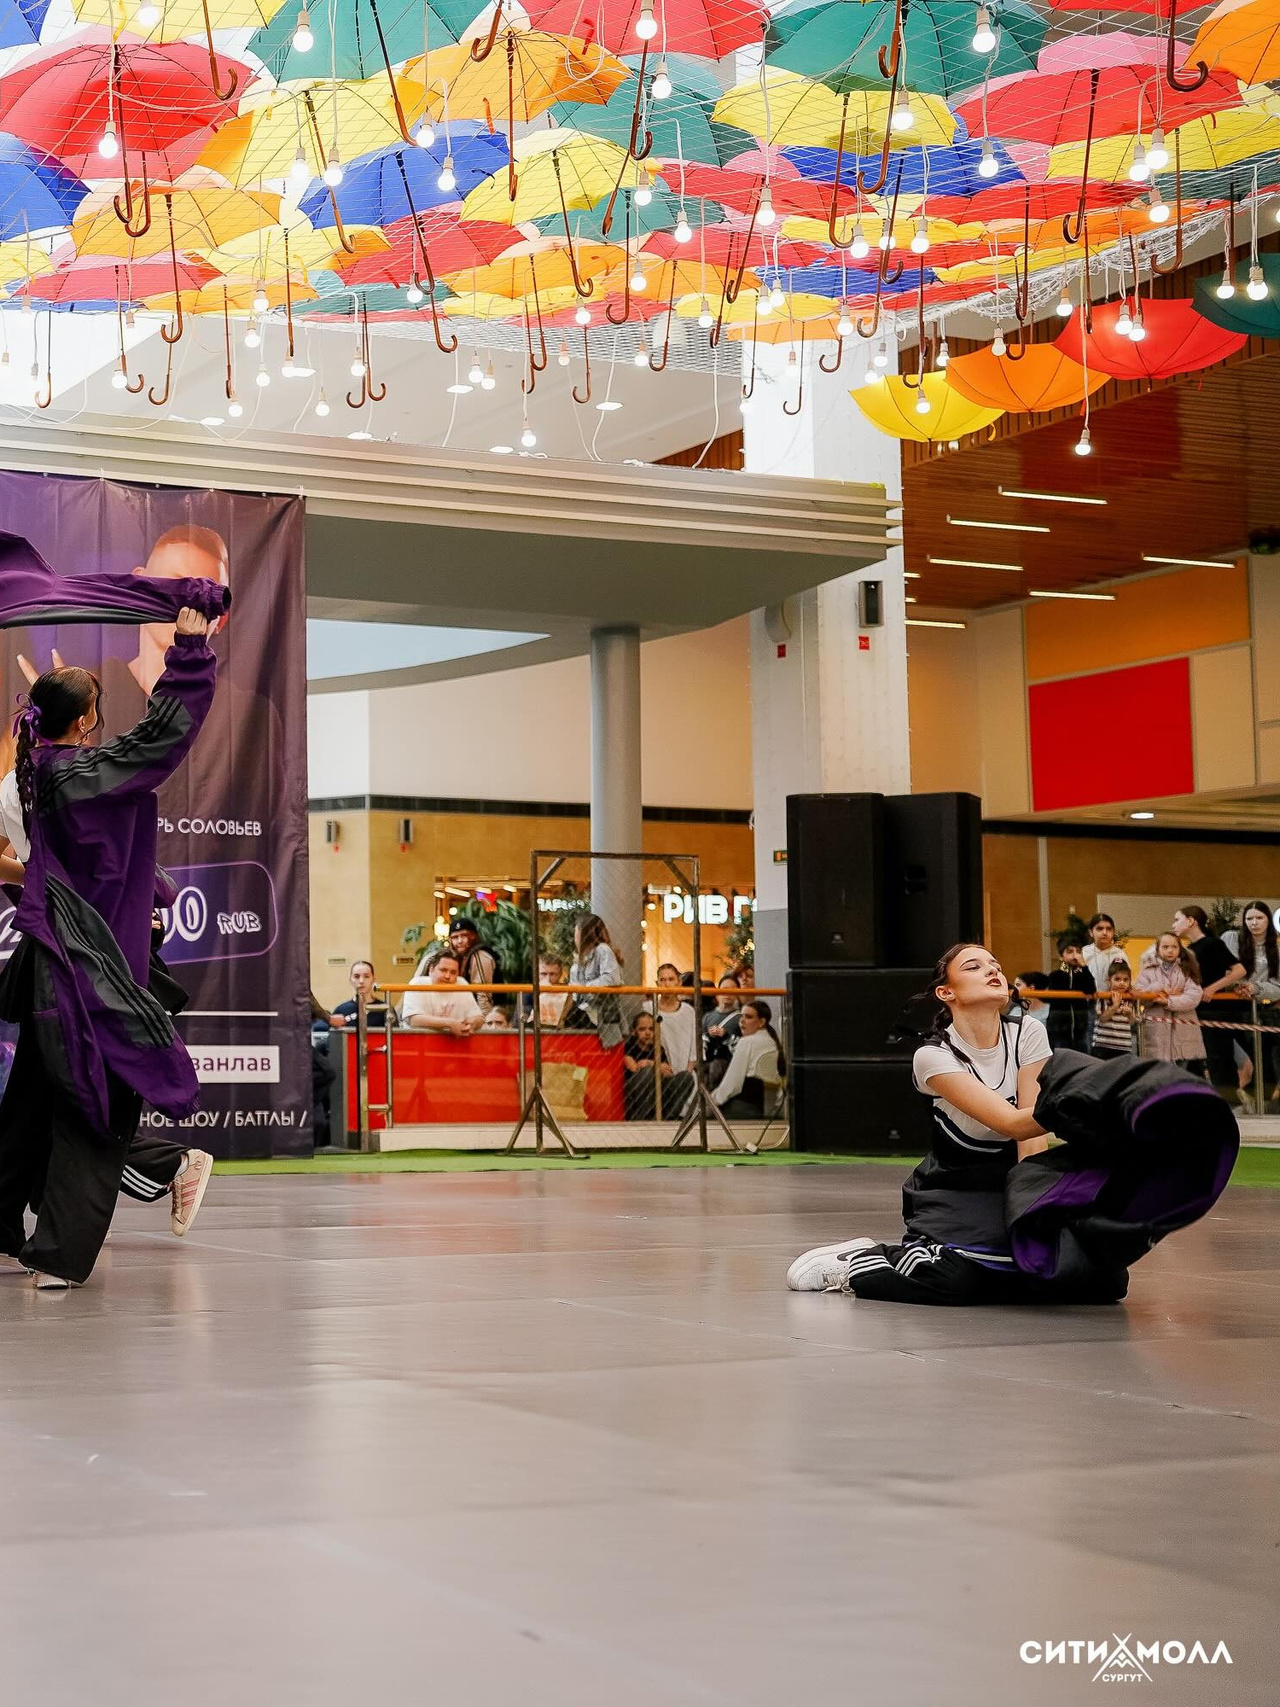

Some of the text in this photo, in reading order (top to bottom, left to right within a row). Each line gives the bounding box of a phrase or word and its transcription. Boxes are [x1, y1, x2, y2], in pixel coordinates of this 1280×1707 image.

[177, 818, 263, 836] СОЛОВЬЕВ
[663, 893, 729, 925] РИВ
[217, 910, 263, 935] RUB
[235, 1110, 295, 1127] БАТТЛЫ
